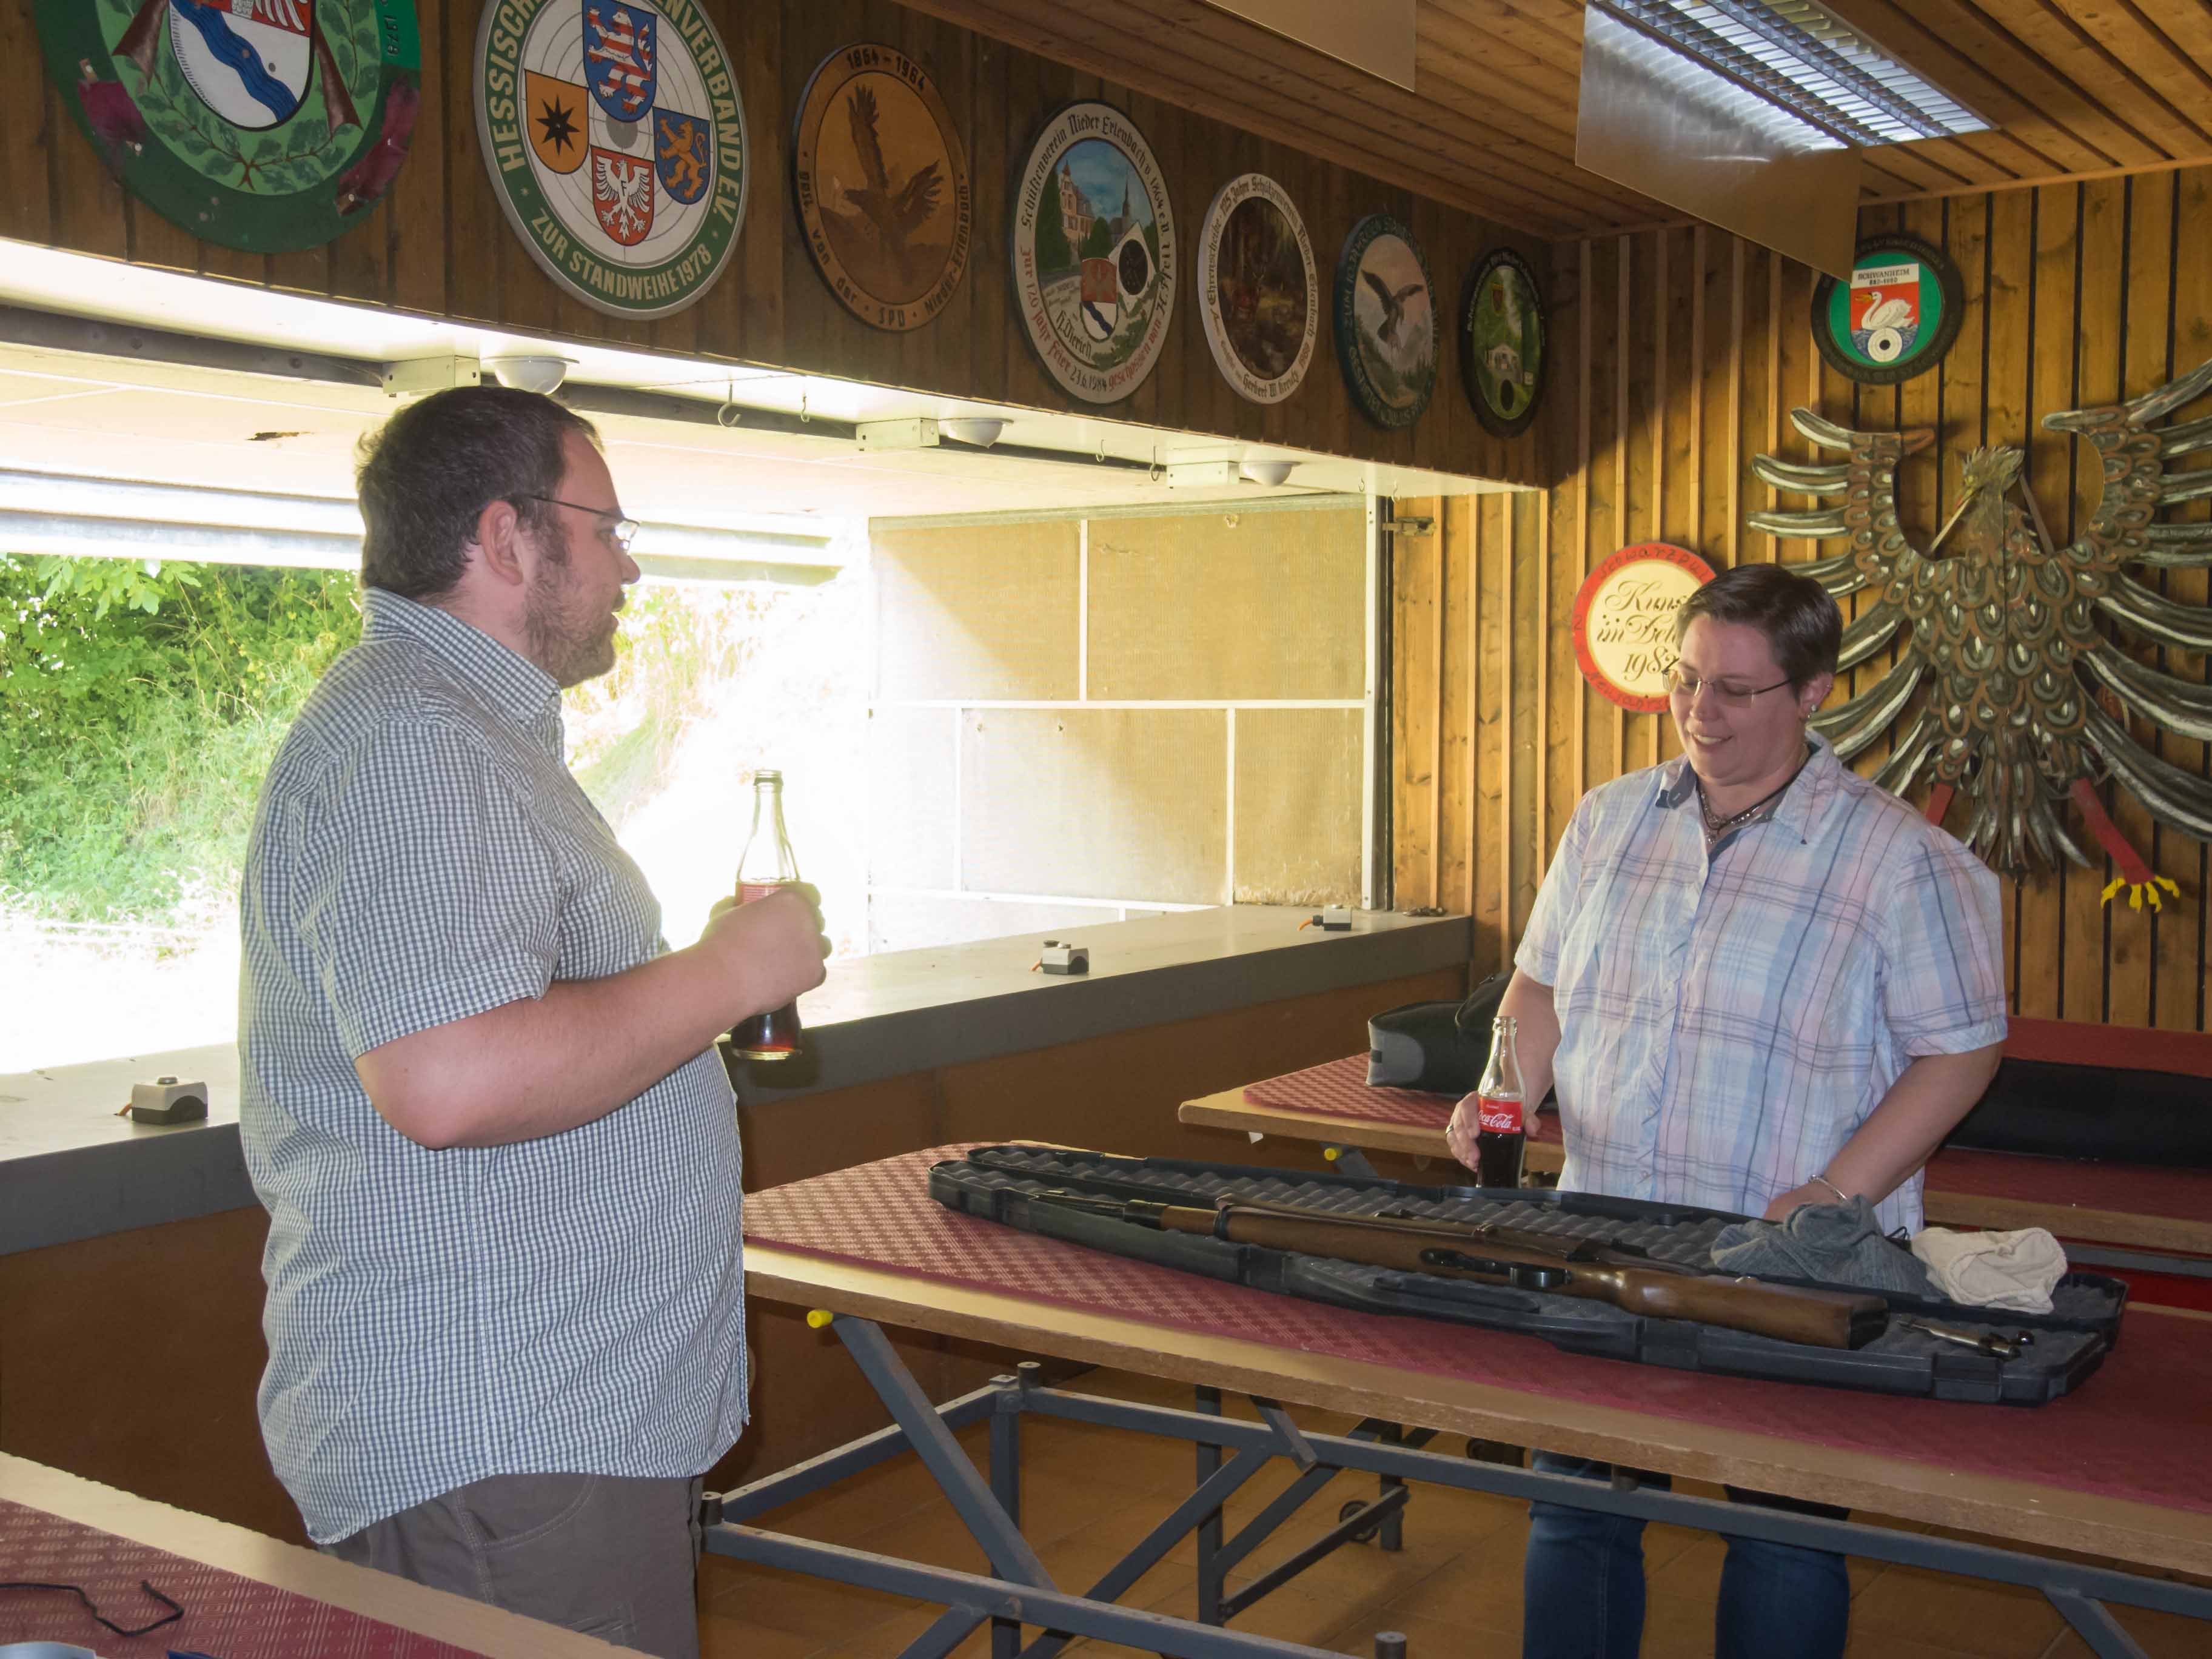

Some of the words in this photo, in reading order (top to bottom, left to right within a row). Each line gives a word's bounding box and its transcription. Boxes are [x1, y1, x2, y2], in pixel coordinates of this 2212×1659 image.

[489, 0, 544, 172] HESSISCH
[656, 0, 741, 170] NVERBAND
[533, 207, 569, 261] ZUR
[569, 251, 680, 301] STANDWEIHE
[677, 243, 712, 286] 1978
[1857, 267, 1910, 280] SCHWANHEIM
[879, 309, 906, 326] SPD
